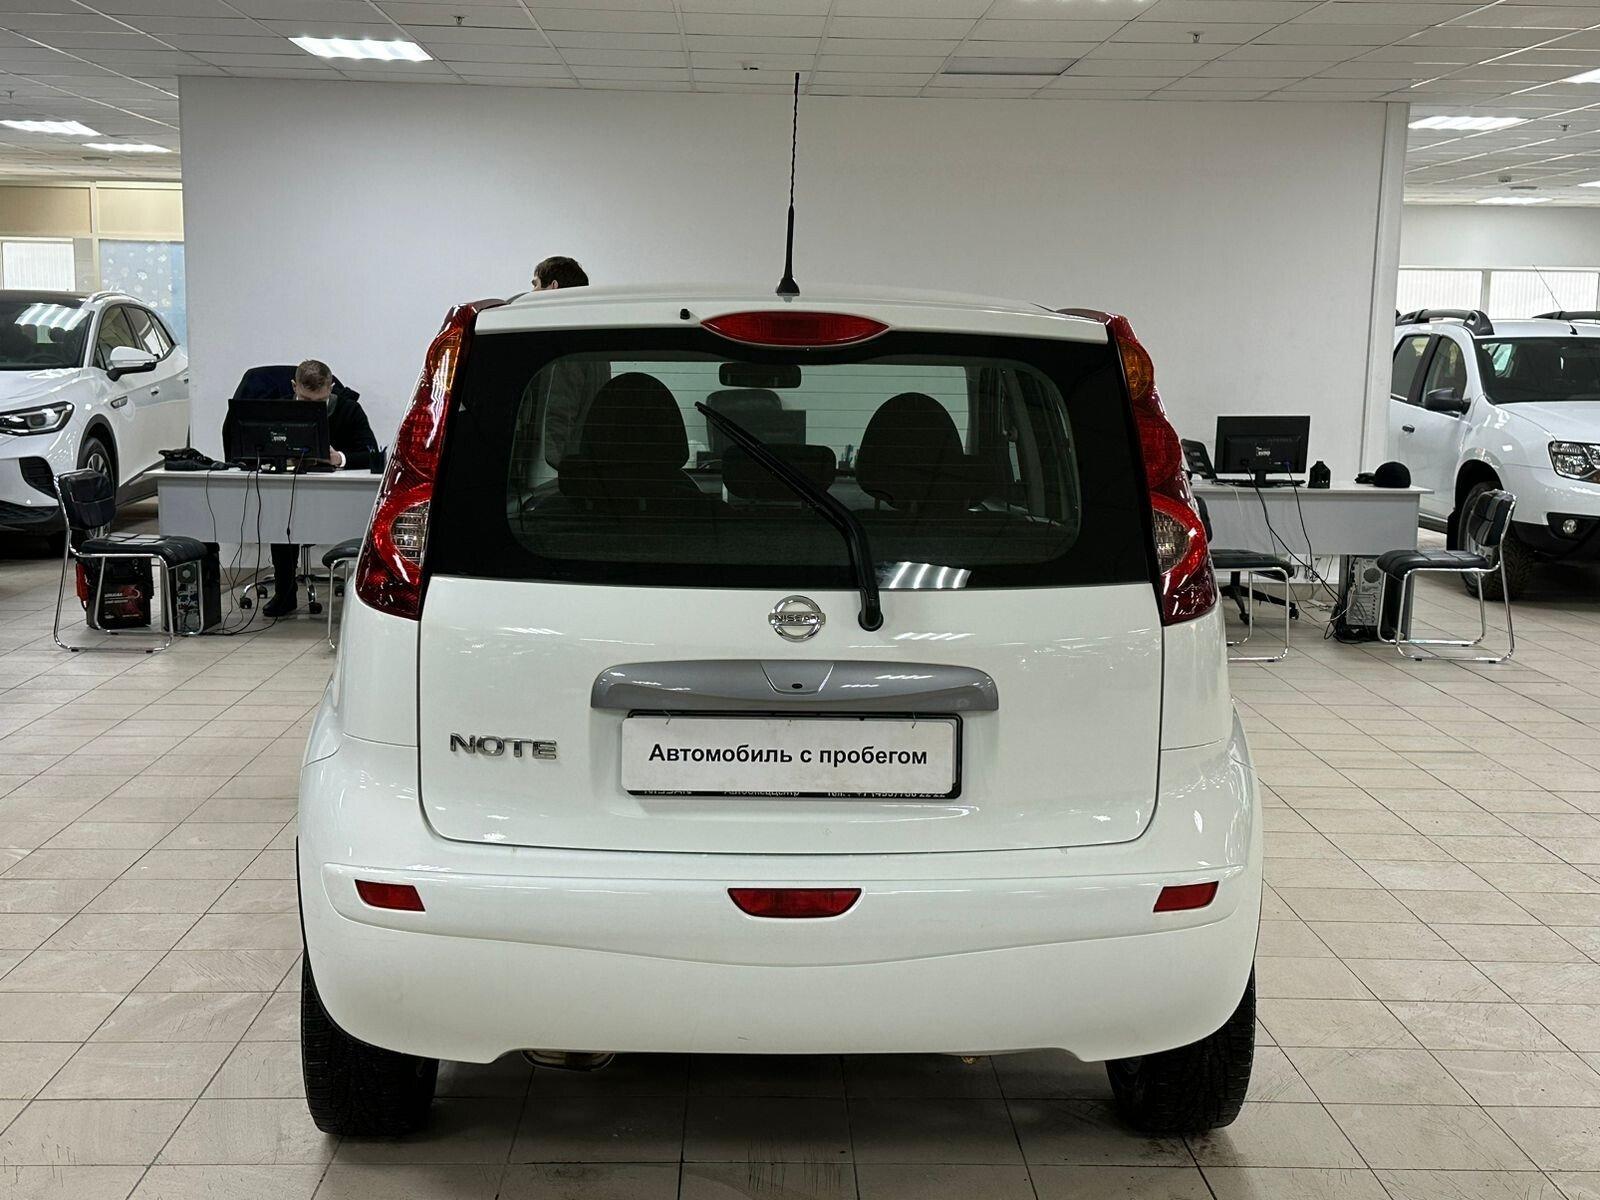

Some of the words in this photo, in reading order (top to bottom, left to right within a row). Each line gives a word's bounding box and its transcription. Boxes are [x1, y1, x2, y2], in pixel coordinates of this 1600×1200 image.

[450, 733, 557, 760] NOTE
[648, 743, 793, 763] Автомобиль
[799, 749, 812, 764] с
[819, 745, 928, 768] пробегом
